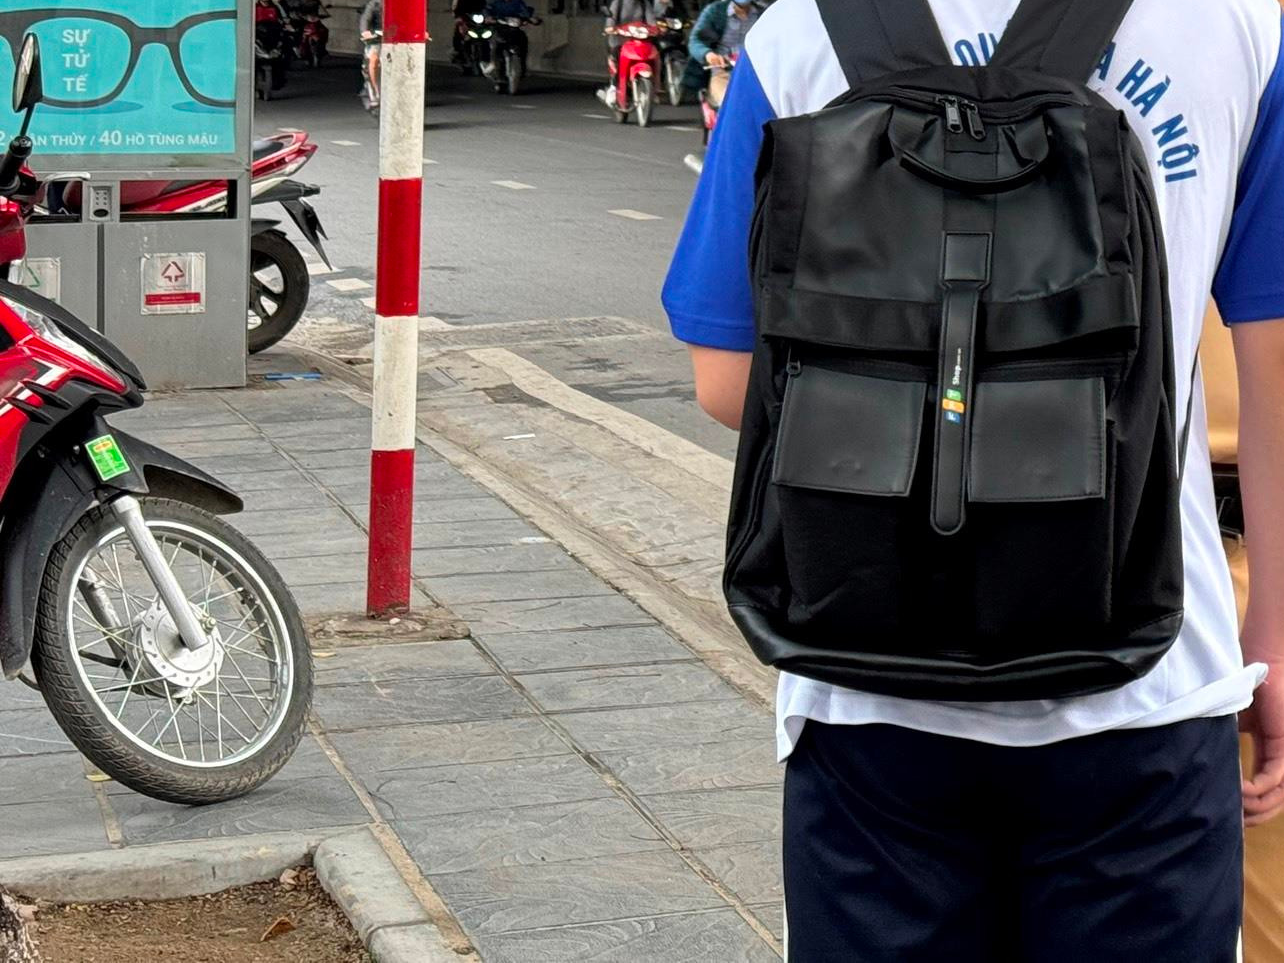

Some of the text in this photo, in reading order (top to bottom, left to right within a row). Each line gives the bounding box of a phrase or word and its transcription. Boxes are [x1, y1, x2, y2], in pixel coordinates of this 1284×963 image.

[62, 28, 91, 47] SỰ
[62, 49, 90, 68] TỬ
[63, 73, 89, 92] TẾ
[1115, 58, 1200, 183] HÀ NỘI
[99, 130, 122, 146] 40
[150, 133, 185, 146] TÙNG
